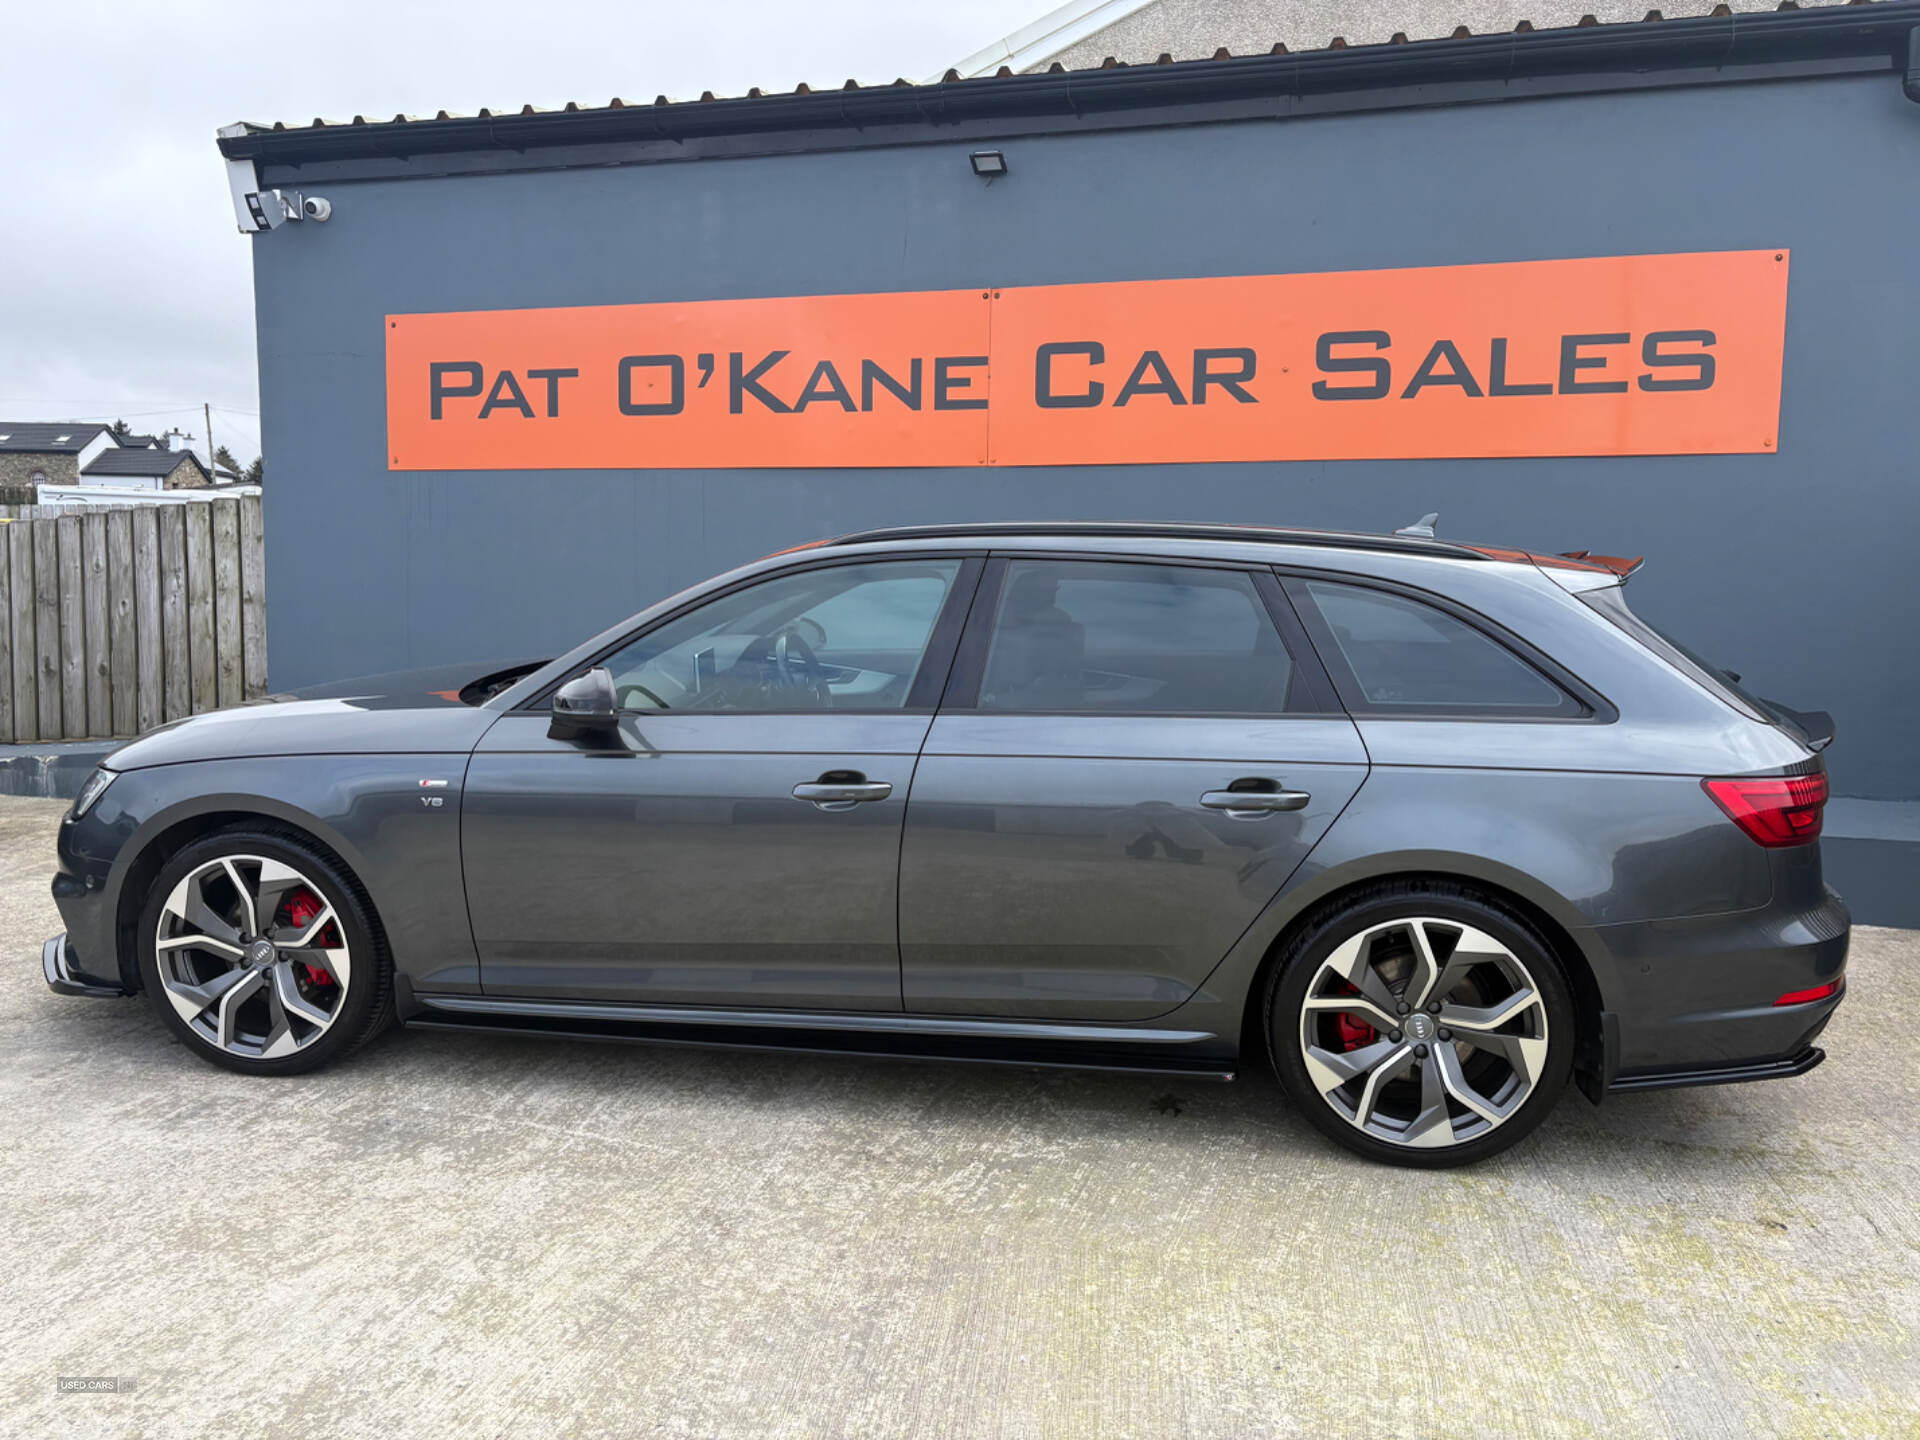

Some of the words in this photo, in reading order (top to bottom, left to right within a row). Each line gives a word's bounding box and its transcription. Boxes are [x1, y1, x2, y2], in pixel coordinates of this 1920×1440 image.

[429, 360, 579, 420] PAT
[617, 350, 990, 416] O'KANE
[1034, 340, 1260, 409] CAR
[1311, 328, 1718, 401] SALES
